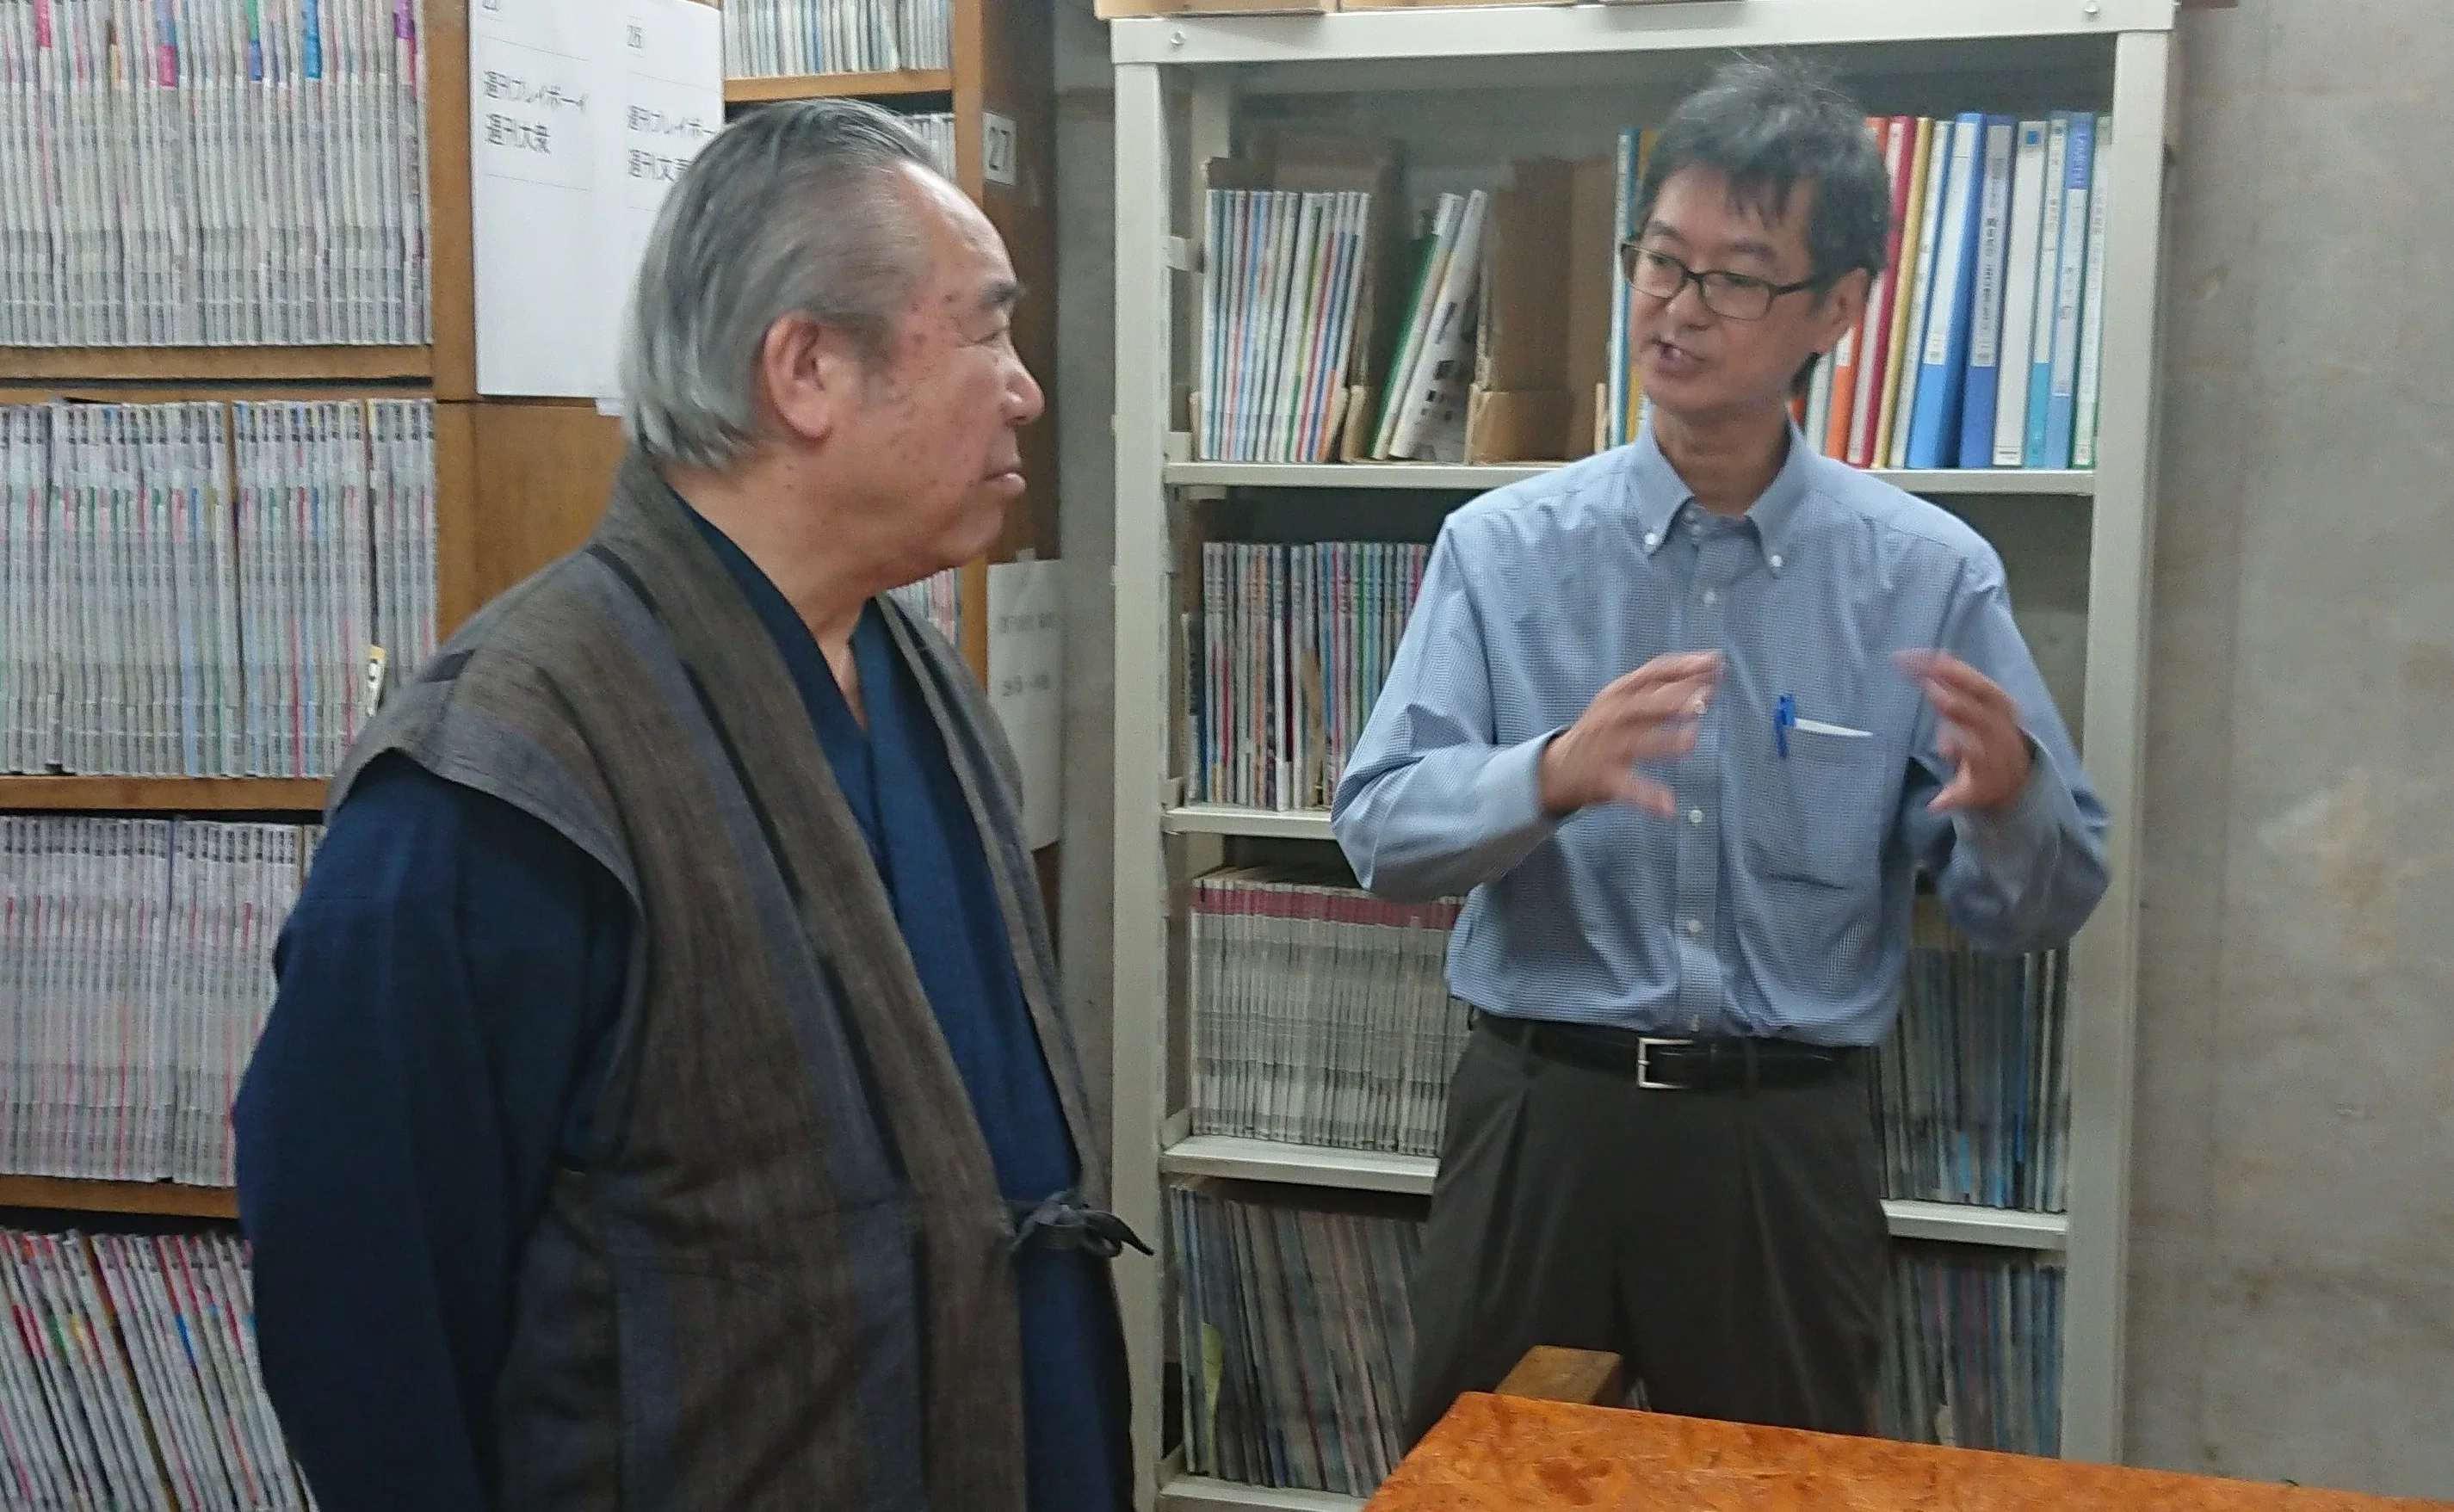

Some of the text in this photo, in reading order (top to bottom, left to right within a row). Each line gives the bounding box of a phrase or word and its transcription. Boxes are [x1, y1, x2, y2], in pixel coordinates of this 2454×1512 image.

[627, 104, 717, 139] 週刊プレイボー
[988, 126, 1011, 171] 27
